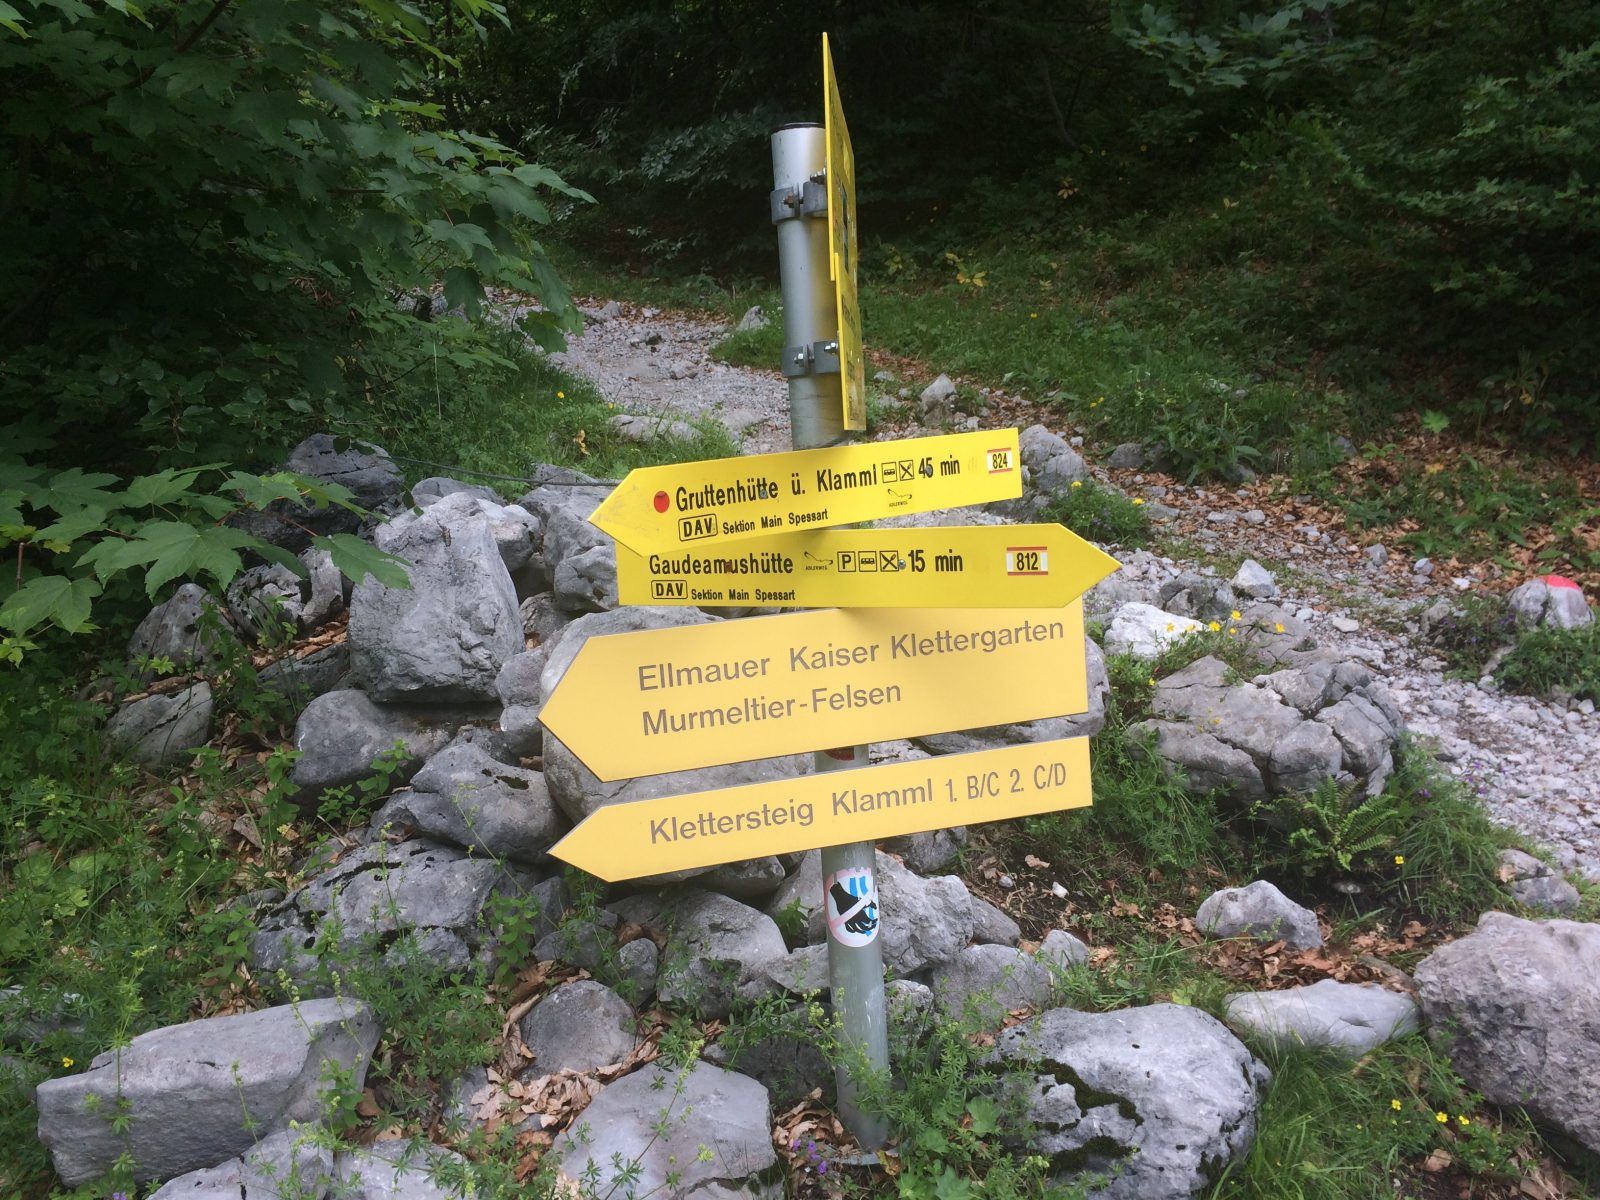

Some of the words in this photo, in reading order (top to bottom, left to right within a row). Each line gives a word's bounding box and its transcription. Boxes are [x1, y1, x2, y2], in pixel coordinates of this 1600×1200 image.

[992, 453, 1008, 469] 824
[676, 477, 778, 512] Gruttenhütte
[791, 473, 805, 494] ü.
[817, 464, 877, 492] Klamml
[918, 457, 934, 478] 45
[940, 455, 960, 477] min
[683, 514, 713, 537] DAV
[722, 519, 755, 535] Sektion
[761, 514, 783, 529] Main
[788, 509, 828, 525] Spessart
[649, 552, 793, 575] Gaudeamushütte
[908, 550, 925, 572] 15
[935, 549, 963, 572] min
[1016, 552, 1039, 571] 812
[655, 583, 684, 597] DAV
[691, 588, 723, 601] Sektion
[729, 588, 750, 601] Main
[755, 588, 796, 602] Spessart
[638, 657, 770, 692] Ellmauer
[789, 642, 880, 672] Kaiser
[891, 619, 1064, 660] Klettergarten
[642, 684, 902, 736] Murmeltier-Felsen
[650, 798, 814, 844] Klettersteig
[832, 778, 933, 816] Klamml
[945, 778, 958, 803] 1.
[967, 771, 1000, 800] B/C
[1009, 768, 1024, 793] 2.
[1033, 762, 1067, 790] C/D
